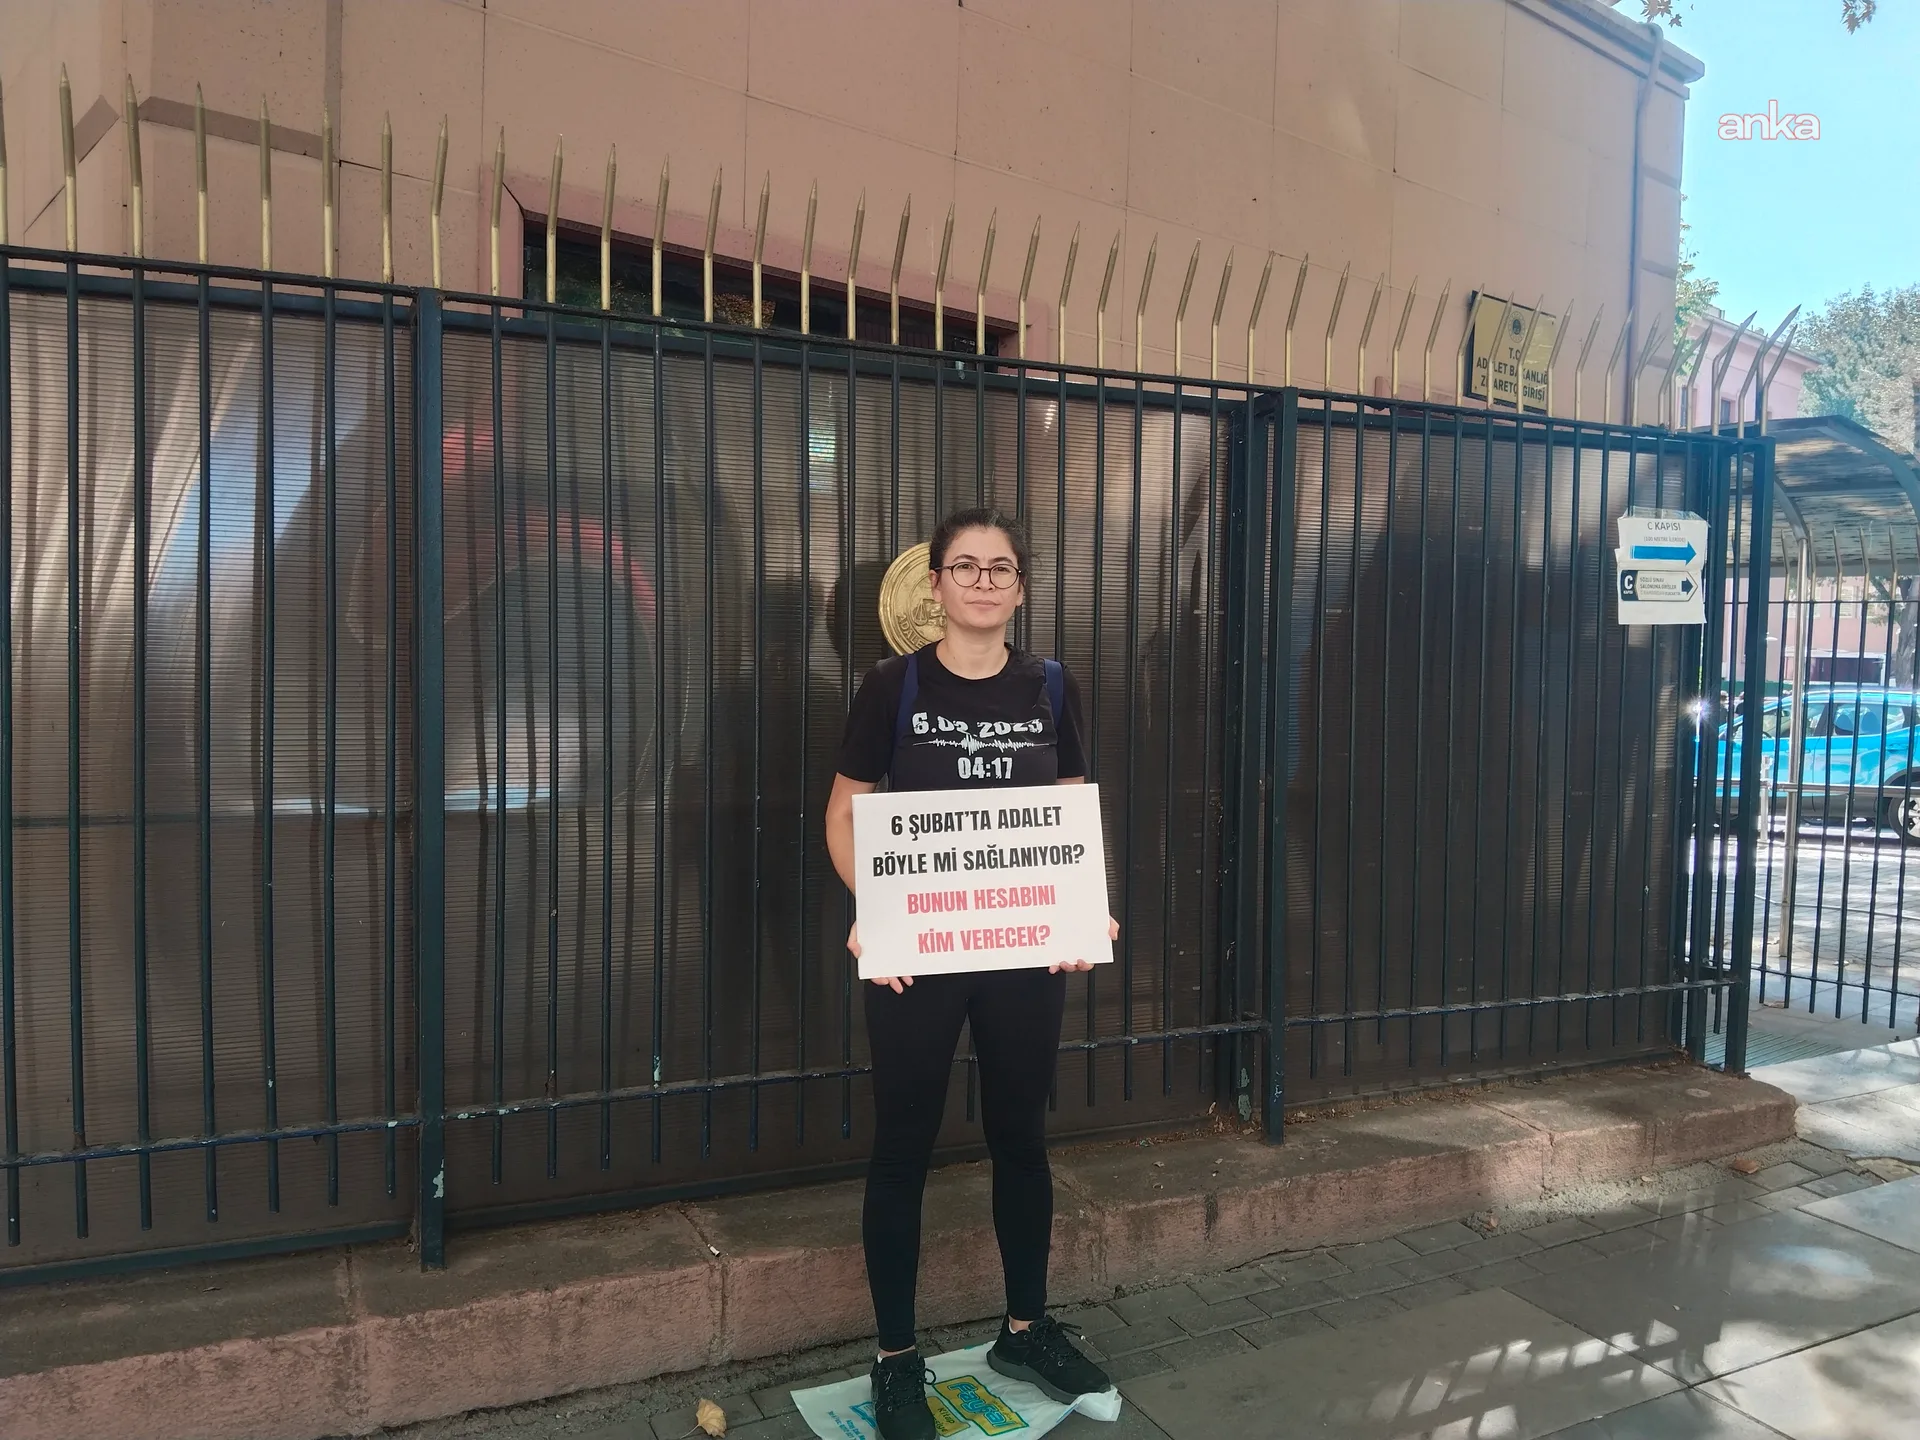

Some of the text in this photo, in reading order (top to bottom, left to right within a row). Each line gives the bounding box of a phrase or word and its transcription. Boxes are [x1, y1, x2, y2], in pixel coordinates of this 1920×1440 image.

[1476, 356, 1508, 375] ADLET
[1647, 521, 1681, 531] C KAPISI
[1624, 575, 1633, 590] C
[896, 612, 926, 649] ADALE
[957, 756, 1013, 780] 04:17
[891, 806, 1062, 841] 6 ŞUBAT’TA ADALET
[873, 843, 1085, 877] BÖYLE Mİ SAĞLANIYOR?
[907, 884, 1056, 914] BUNUN HESABINI
[918, 925, 1051, 954] KİM VERECEK?
